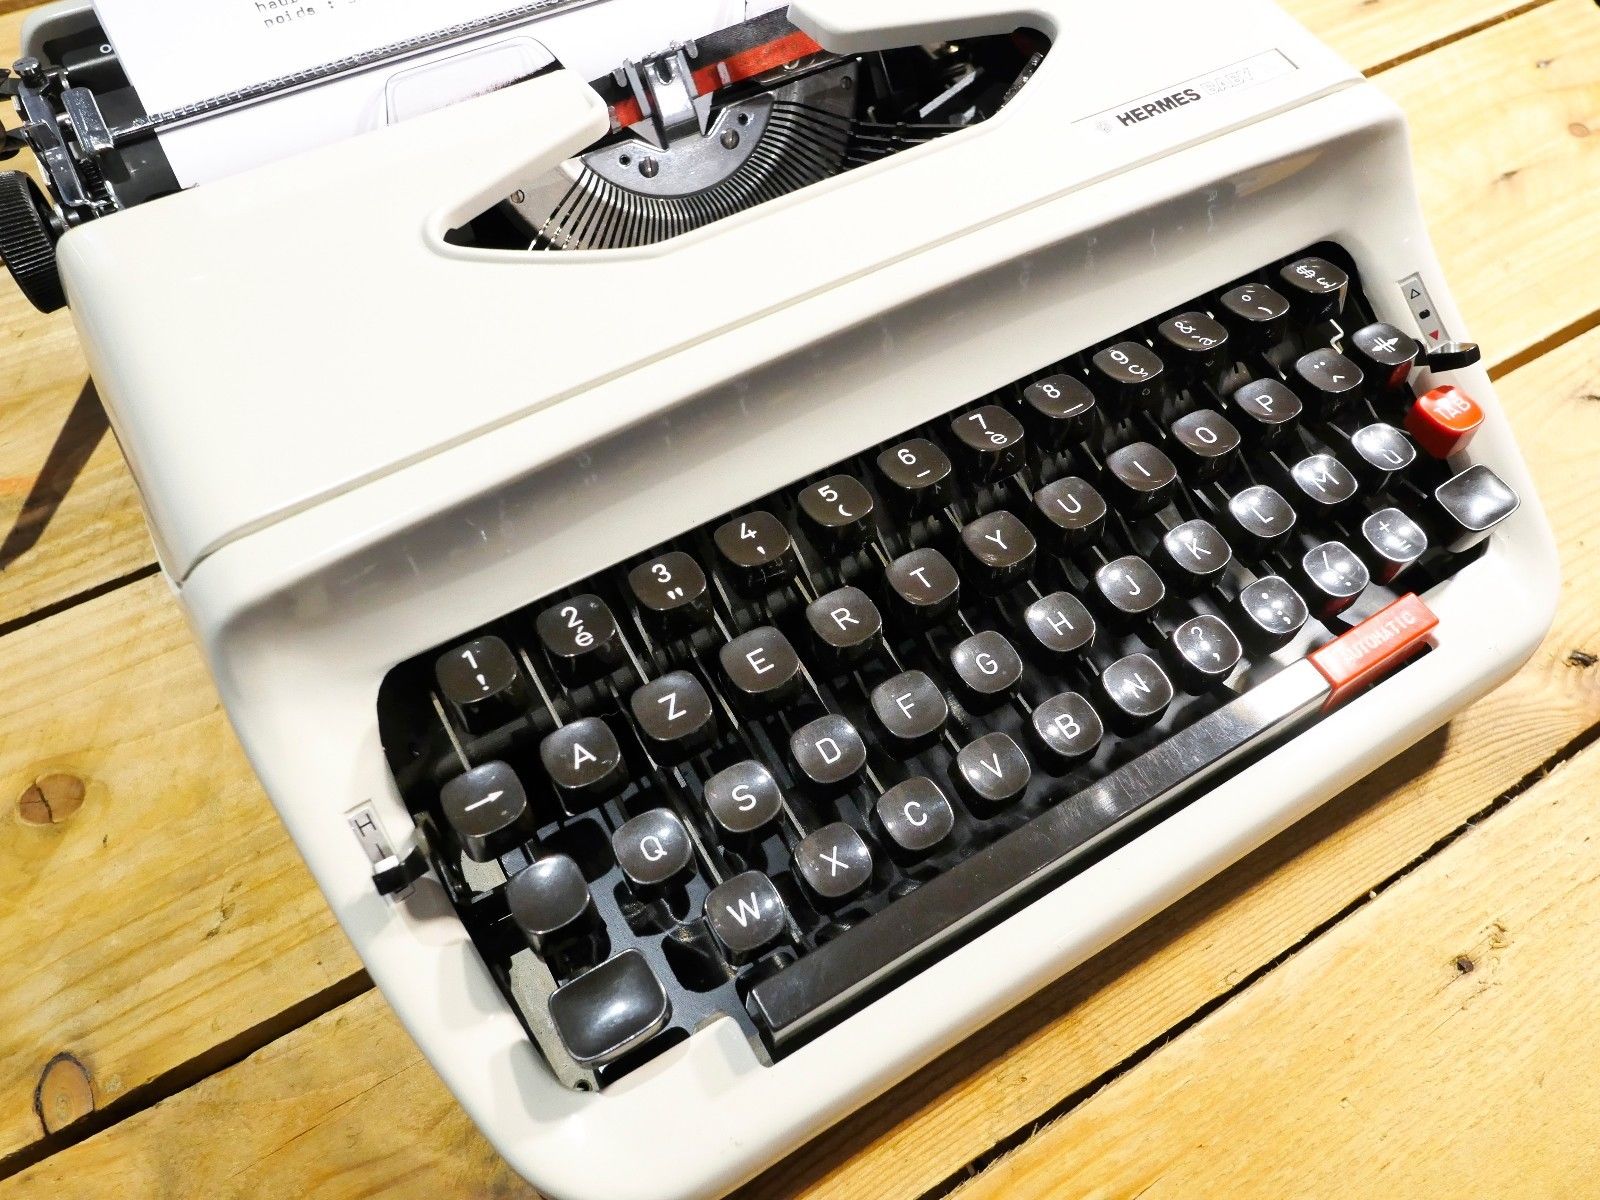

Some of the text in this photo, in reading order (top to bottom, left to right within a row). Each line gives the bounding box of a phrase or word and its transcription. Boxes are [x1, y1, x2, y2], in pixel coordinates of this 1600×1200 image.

[1115, 88, 1202, 127] HERMES
[1174, 321, 1197, 335] &
[1109, 350, 1129, 365] 9
[1042, 384, 1061, 399] 8
[1255, 395, 1273, 412] P
[1432, 397, 1472, 421] TAB
[968, 413, 988, 430] 7
[984, 430, 1008, 445] è
[1195, 427, 1218, 444] O
[897, 448, 916, 465] 6
[1133, 460, 1151, 477] I
[1311, 469, 1340, 493] M
[817, 484, 838, 502] 5
[1056, 494, 1082, 514] U
[1250, 505, 1275, 524] L
[740, 522, 758, 540] 4
[985, 529, 1008, 550] Y
[1185, 538, 1212, 560] K
[651, 563, 672, 583] 3
[909, 566, 932, 588] T
[1124, 574, 1142, 596] J
[560, 606, 583, 629] 2
[830, 607, 860, 631] R
[1046, 611, 1074, 636] H
[575, 625, 595, 647] é
[461, 650, 478, 669] 1
[746, 647, 775, 675] E
[975, 653, 999, 675] G
[476, 674, 490, 691] !
[1123, 672, 1151, 699] N
[657, 692, 687, 721] Z
[895, 692, 917, 720] F
[1054, 713, 1081, 740] B
[573, 742, 597, 770] A
[815, 737, 842, 765] D
[980, 753, 1003, 778] V
[731, 784, 757, 812] S
[903, 801, 928, 826] C
[354, 813, 377, 838] H
[640, 835, 668, 862] Q
[819, 845, 850, 877] X
[725, 892, 762, 928] W
